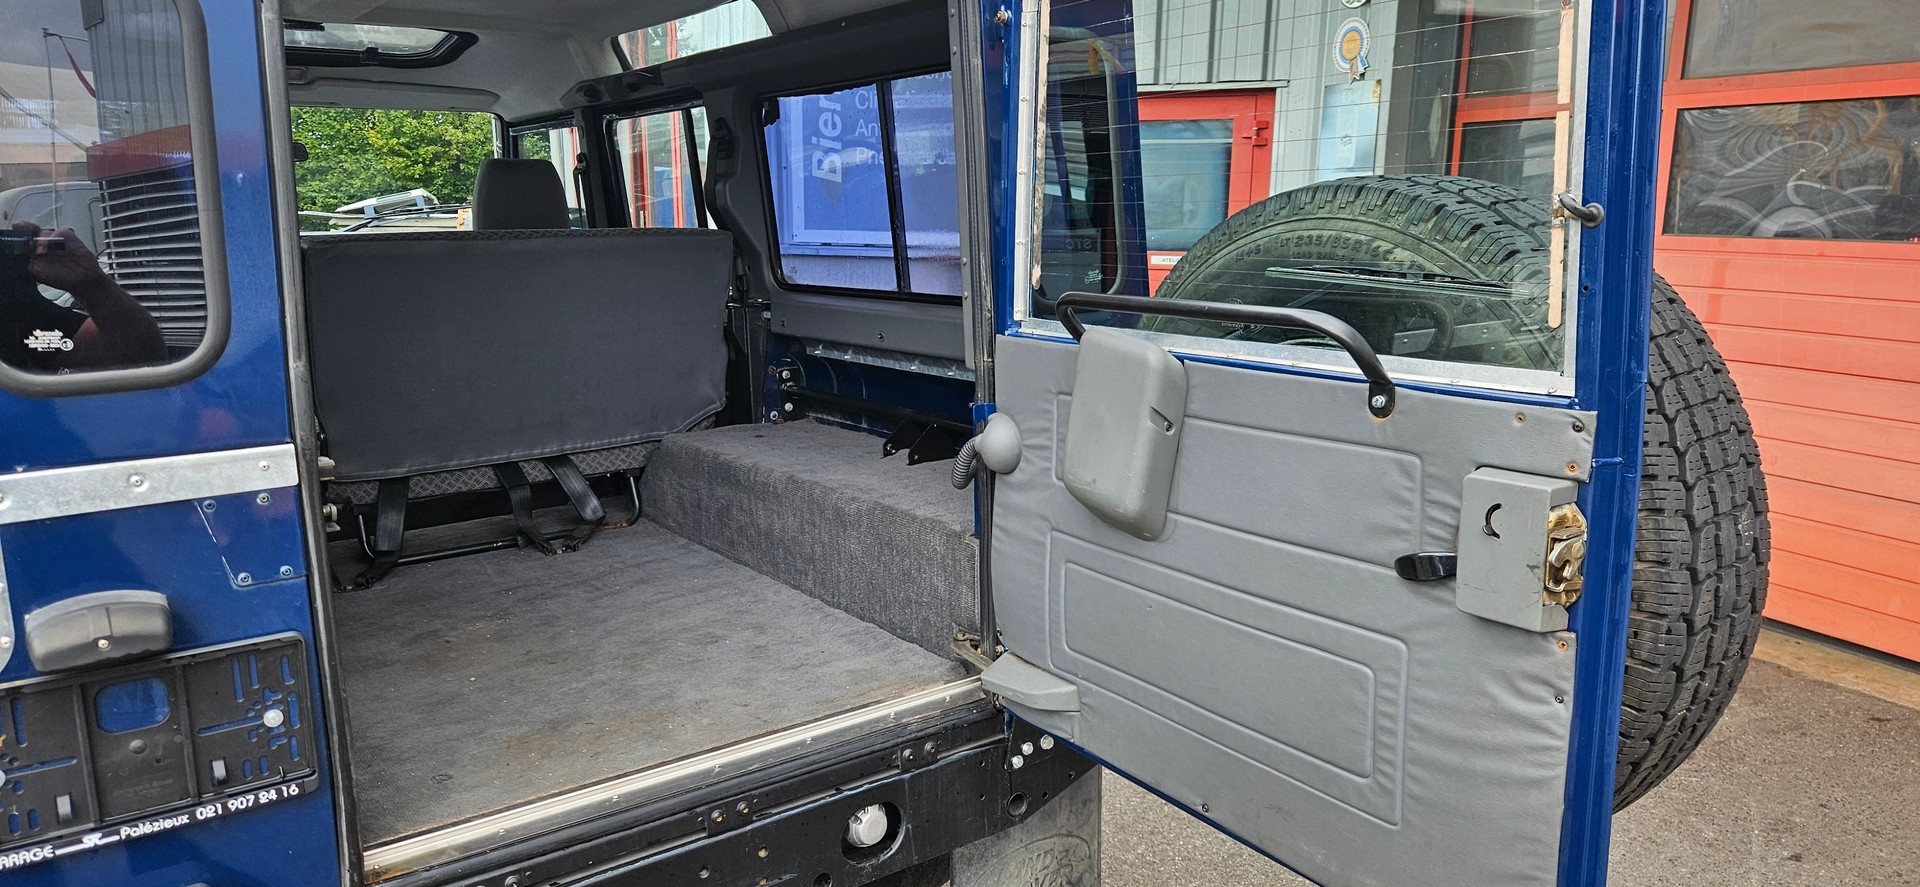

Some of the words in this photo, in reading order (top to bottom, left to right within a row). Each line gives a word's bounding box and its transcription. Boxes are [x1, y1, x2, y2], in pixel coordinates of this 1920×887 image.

[0, 845, 54, 870] ARAGE
[120, 814, 190, 840] Palézieux
[195, 803, 223, 820] 021
[227, 794, 255, 812] 907
[258, 789, 278, 804] 24
[281, 783, 300, 798] 16
